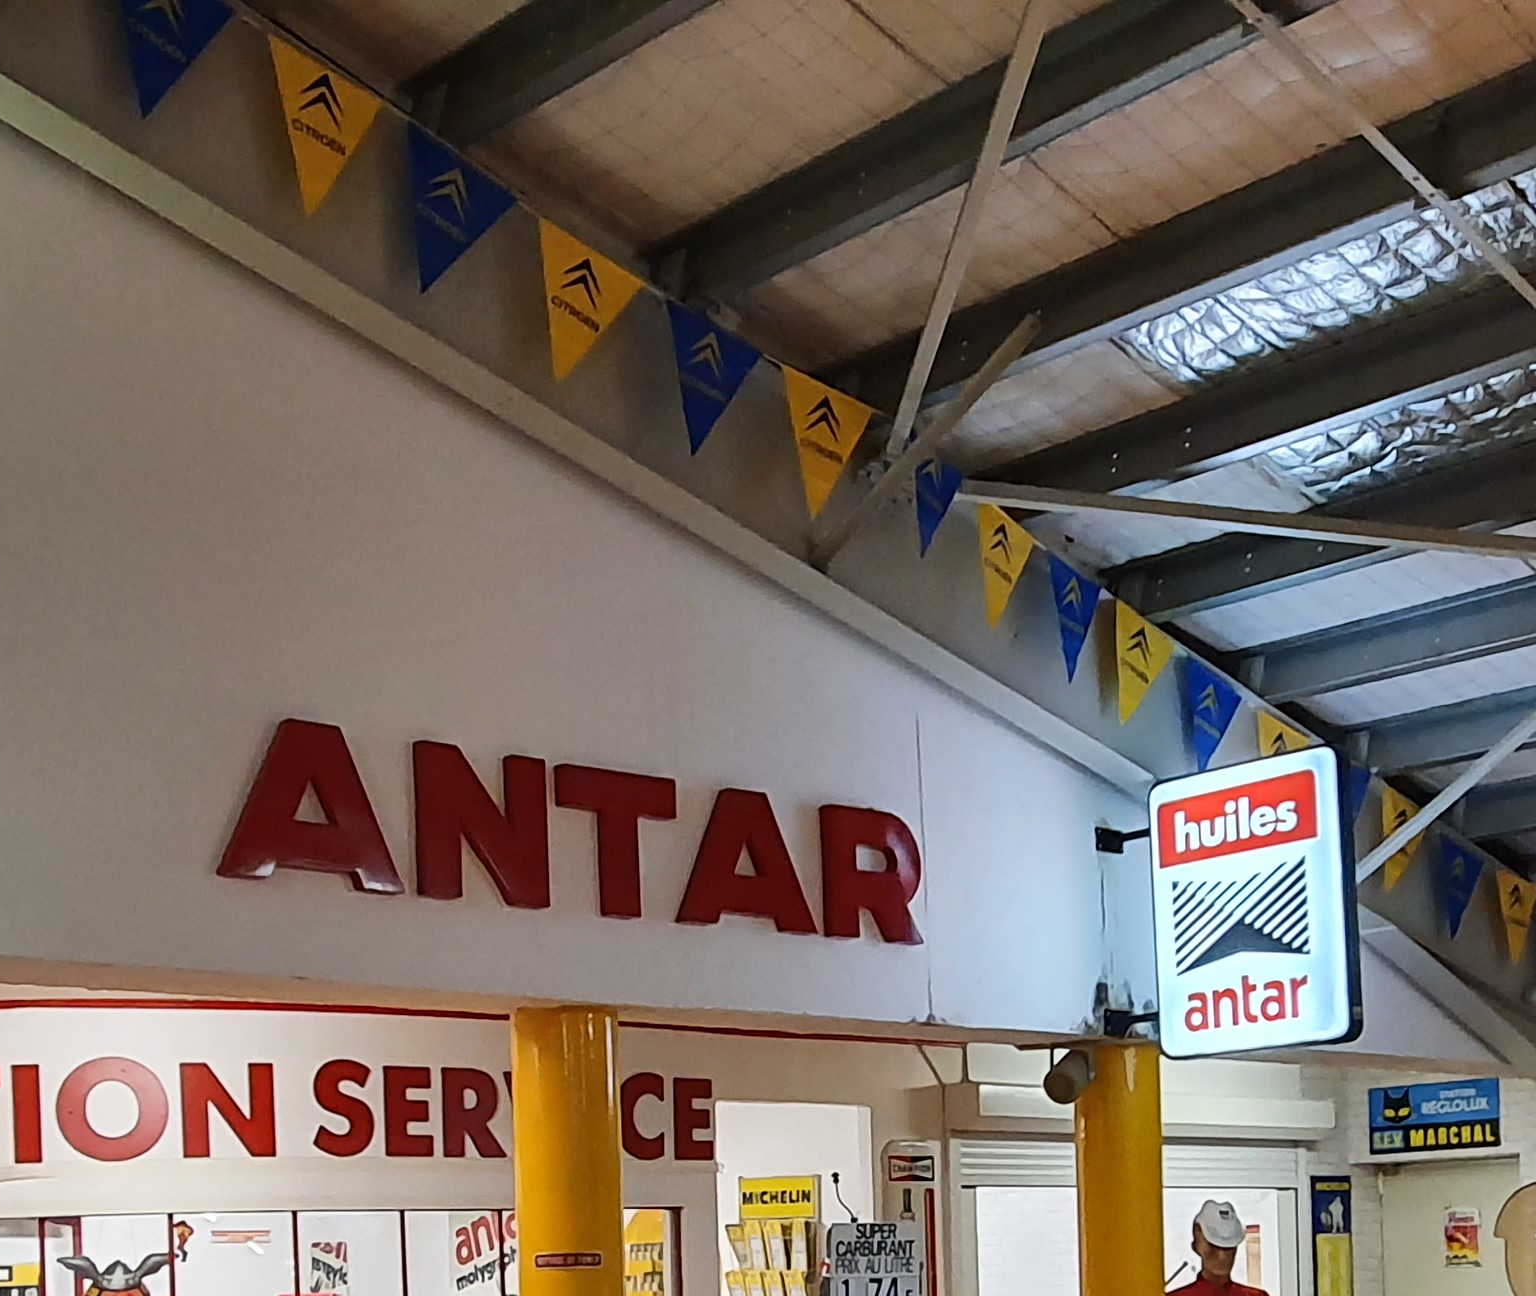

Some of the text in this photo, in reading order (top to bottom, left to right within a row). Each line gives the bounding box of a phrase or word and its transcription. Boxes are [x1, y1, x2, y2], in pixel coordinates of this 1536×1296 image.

[216, 718, 924, 945] ANTAR
[1174, 796, 1299, 854] huiles
[1184, 974, 1308, 1033] antar
[313, 1058, 714, 1161] SERCE
[1409, 1123, 1496, 1147] MARCHAL
[742, 1189, 811, 1205] MICHELIN
[855, 1223, 897, 1239] SUPER
[835, 1240, 915, 1258] CARBURANT
[835, 1257, 914, 1274] PRIX AU LITRE
